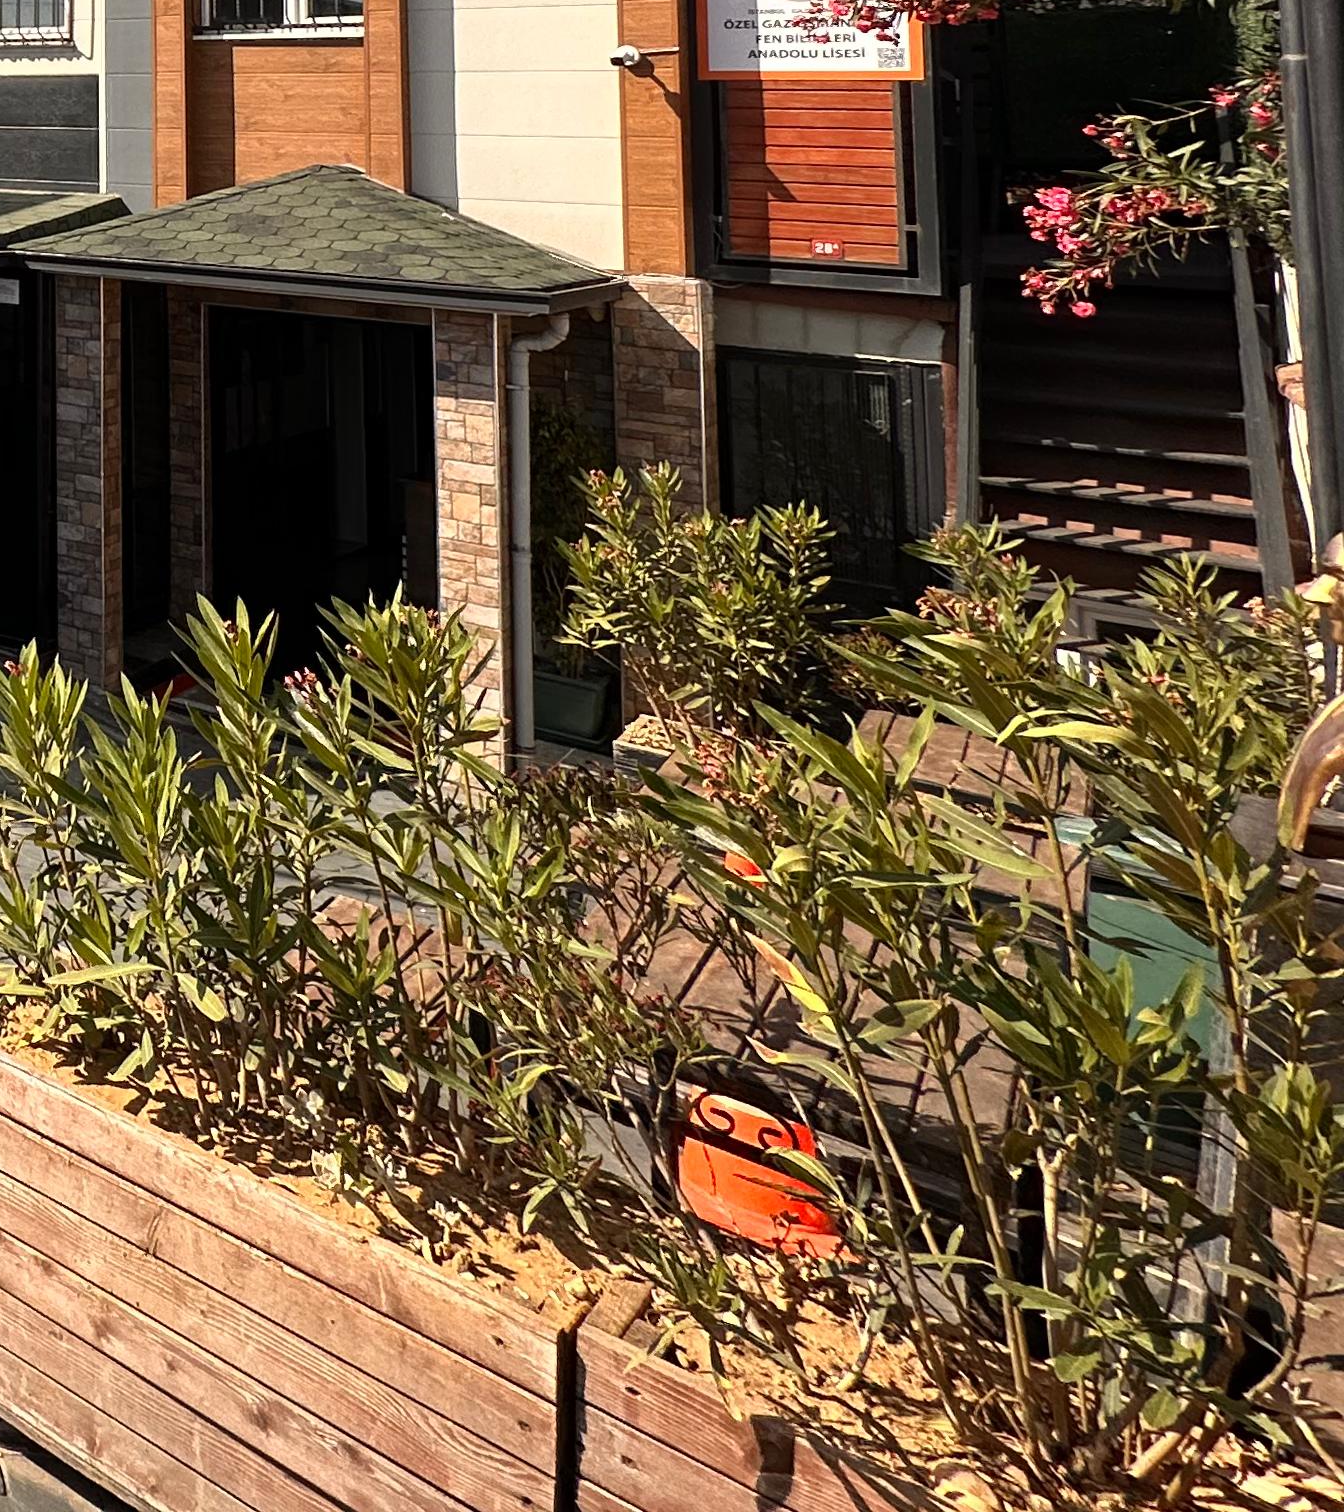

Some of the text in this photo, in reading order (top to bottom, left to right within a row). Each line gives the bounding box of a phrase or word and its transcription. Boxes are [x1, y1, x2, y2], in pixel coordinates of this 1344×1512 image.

[723, 19, 759, 30] ÖZEL
[755, 35, 782, 44] FEN
[747, 46, 866, 59] ANADOLU LİSESİ
